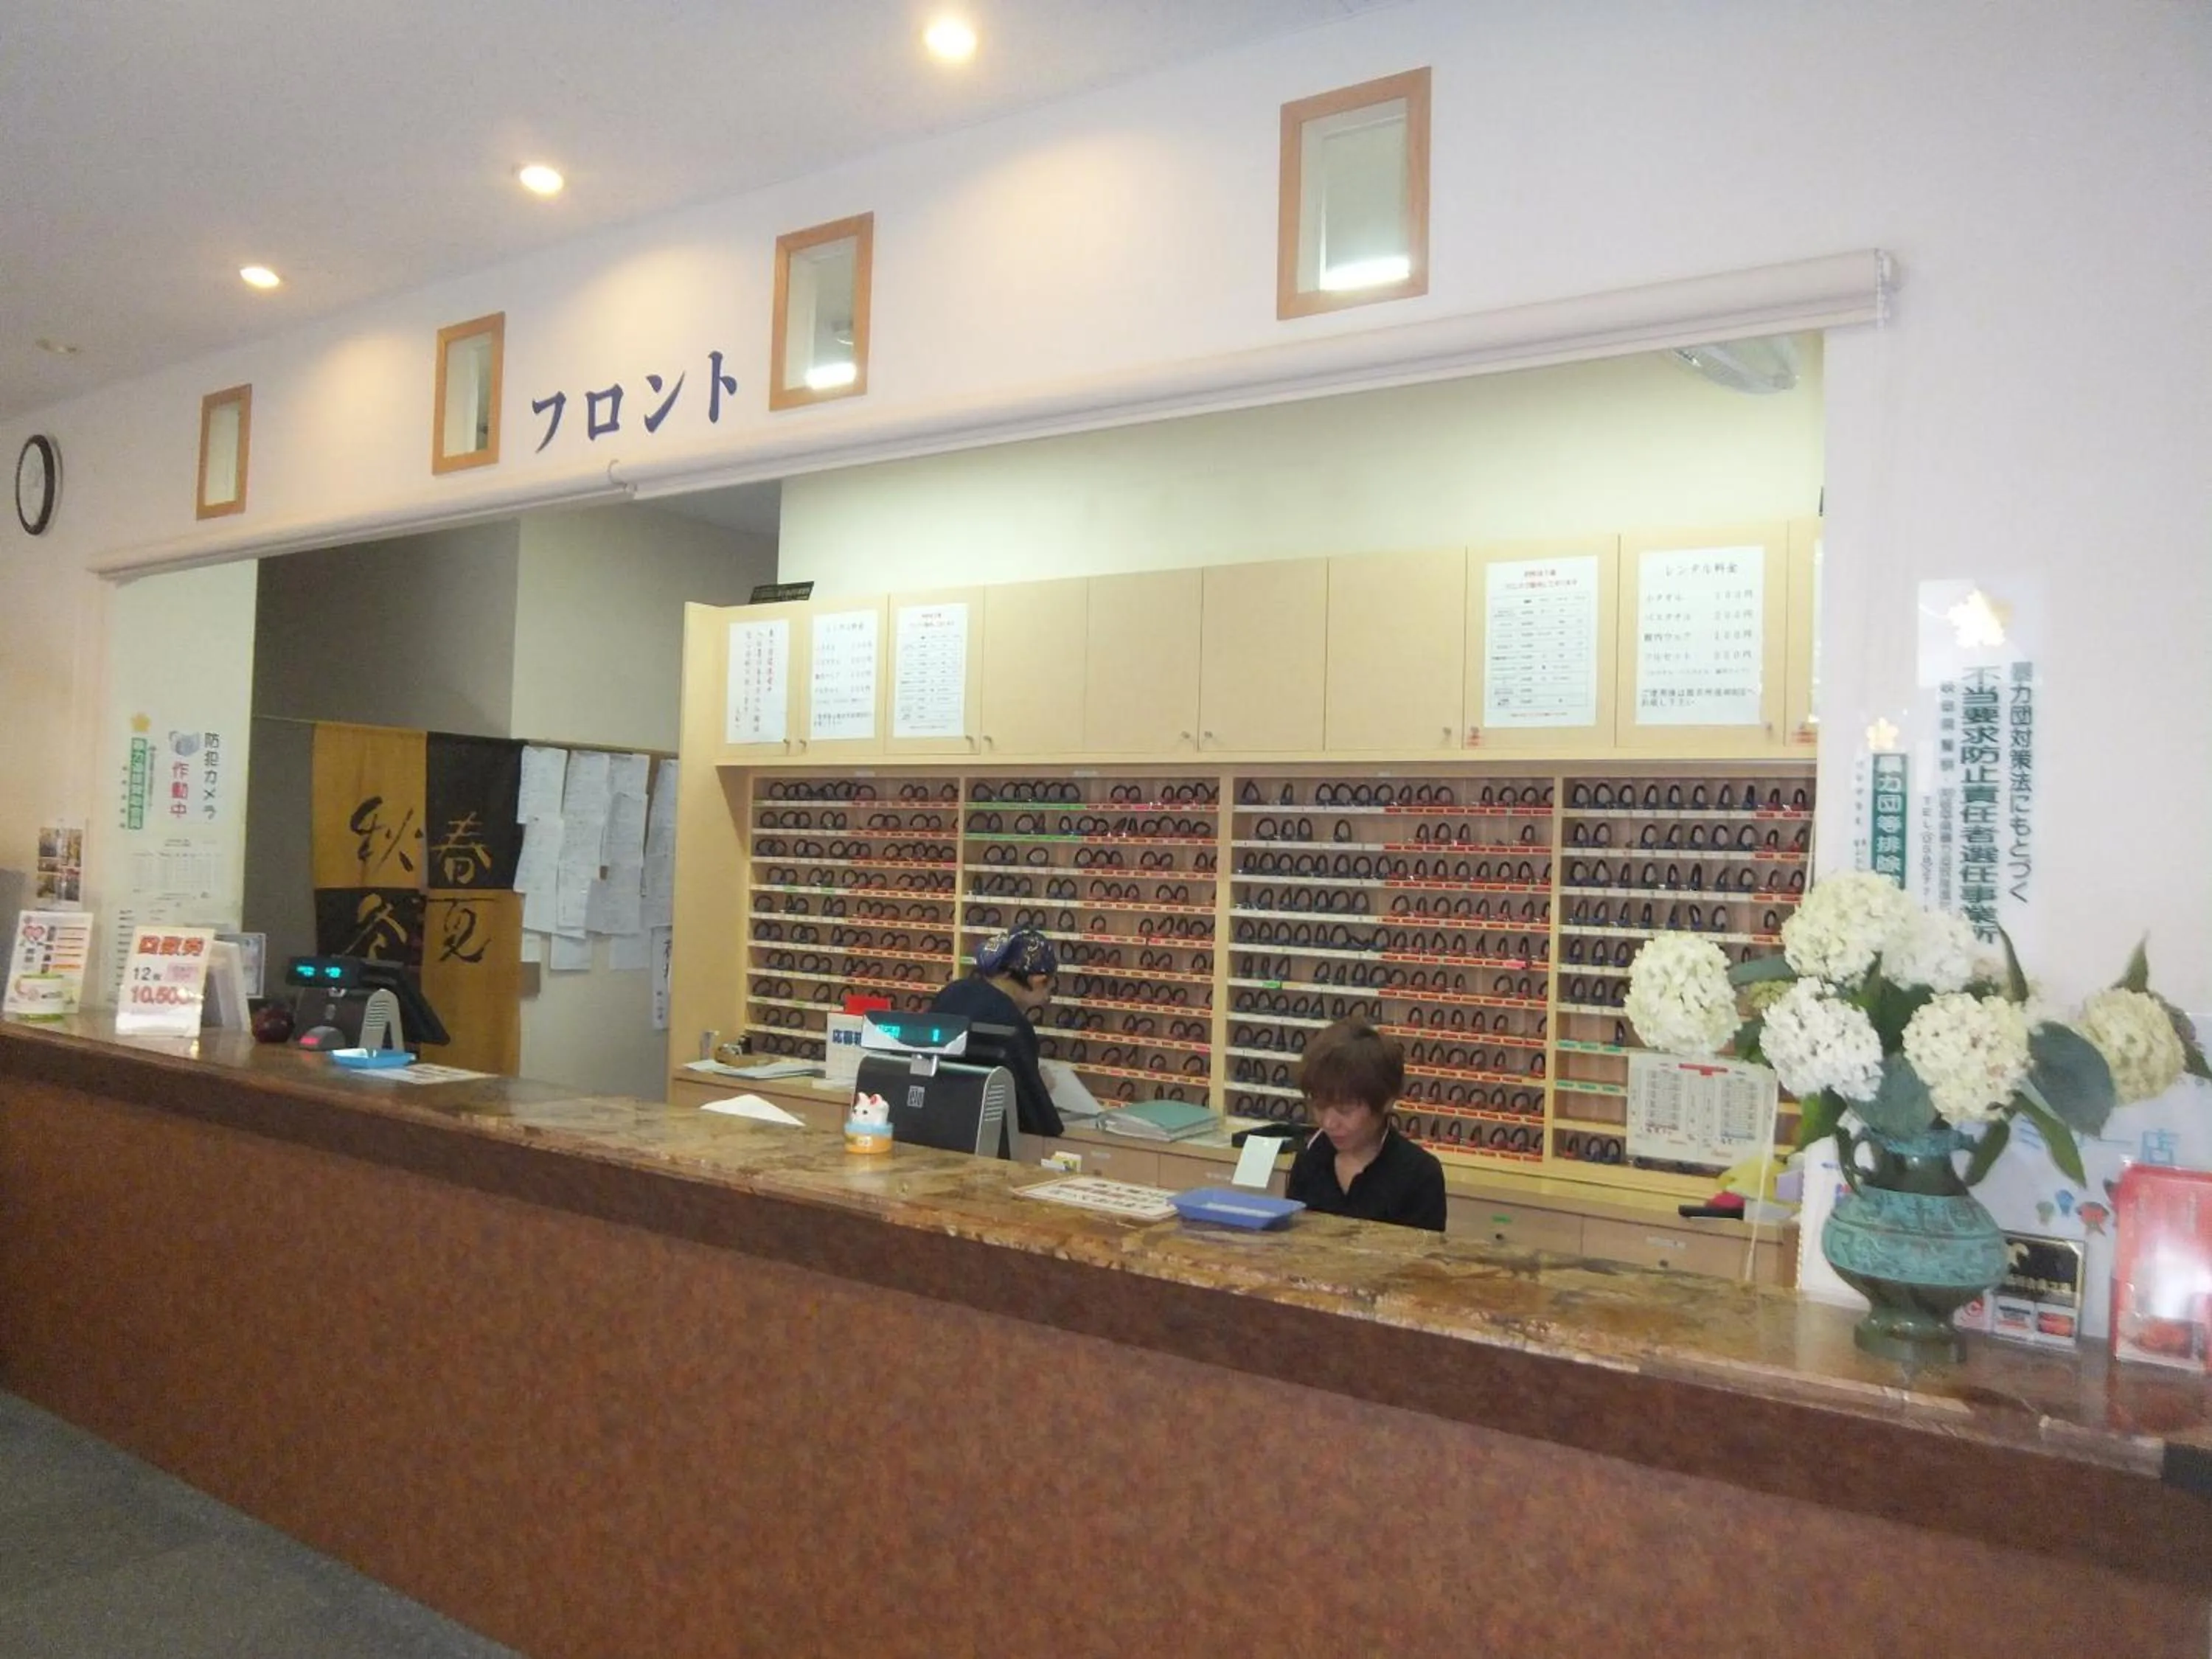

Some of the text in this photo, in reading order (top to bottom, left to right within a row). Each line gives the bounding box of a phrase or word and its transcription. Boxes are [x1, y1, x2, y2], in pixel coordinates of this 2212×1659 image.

[532, 350, 737, 454] フロント
[169, 761, 189, 818] 作動中
[203, 731, 220, 820] 防犯カメラ
[429, 810, 493, 886] 春
